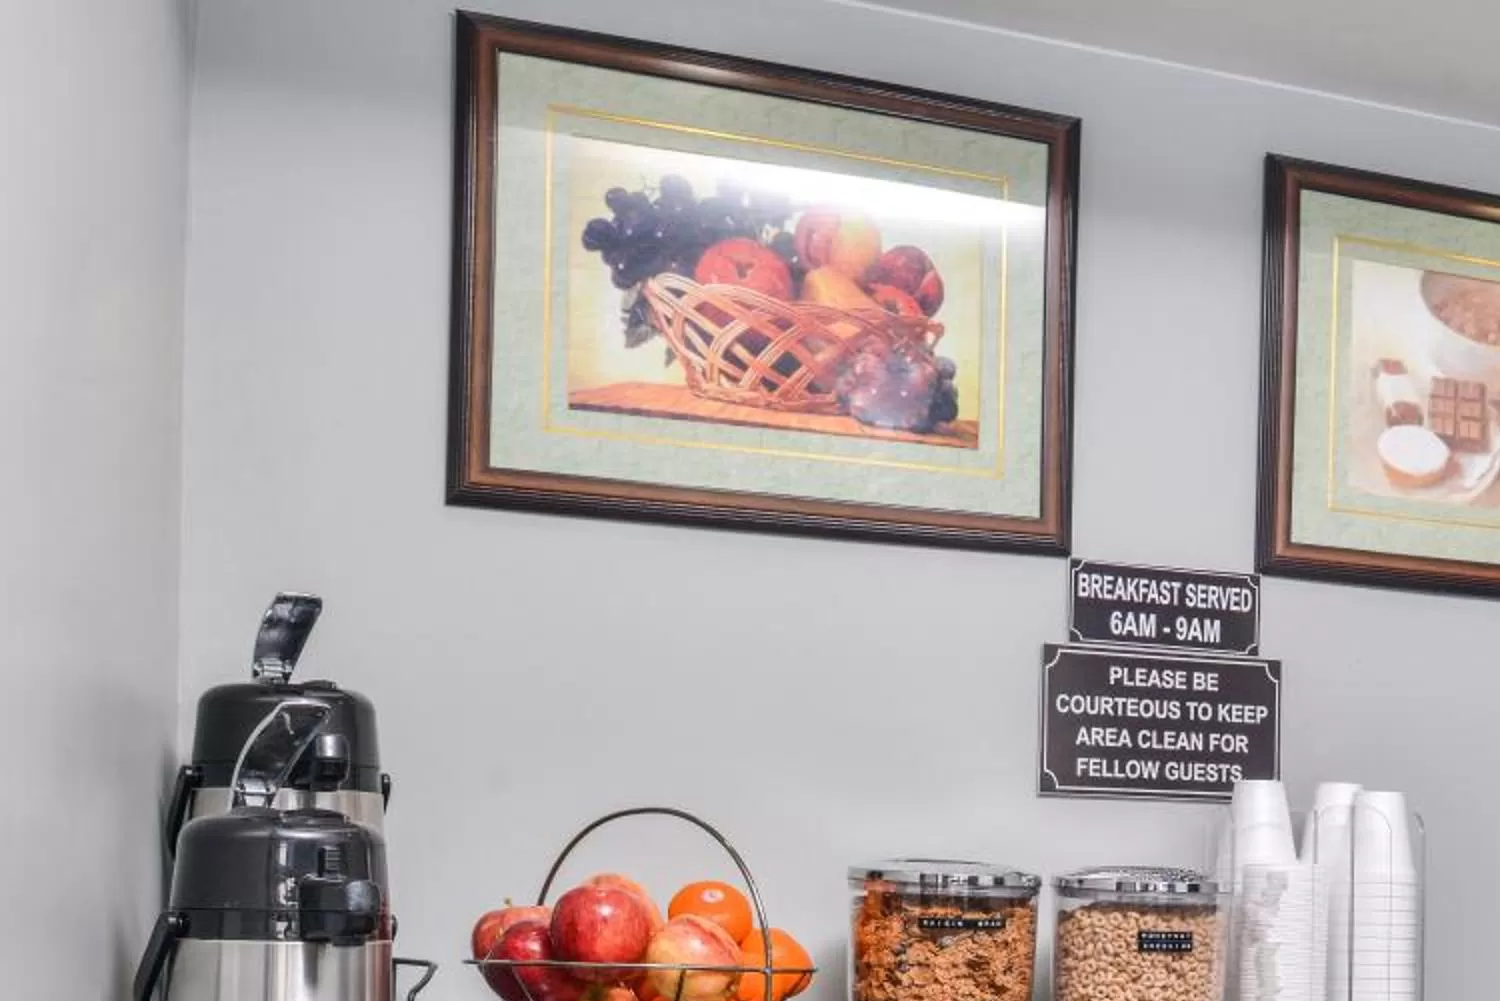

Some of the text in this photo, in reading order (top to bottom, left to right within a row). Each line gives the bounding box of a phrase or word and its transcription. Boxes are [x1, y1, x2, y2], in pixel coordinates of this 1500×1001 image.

[1077, 573, 1252, 613] BREAKFAST SERVED
[1110, 611, 1157, 638] 6AM
[1175, 616, 1221, 643] 9AM
[1109, 666, 1219, 692] PLEASE BE
[1056, 694, 1269, 724] COURTEOUS TO KEEP
[1076, 727, 1249, 753] AREA CLEAN FOR
[1076, 757, 1160, 780] FELLOW
